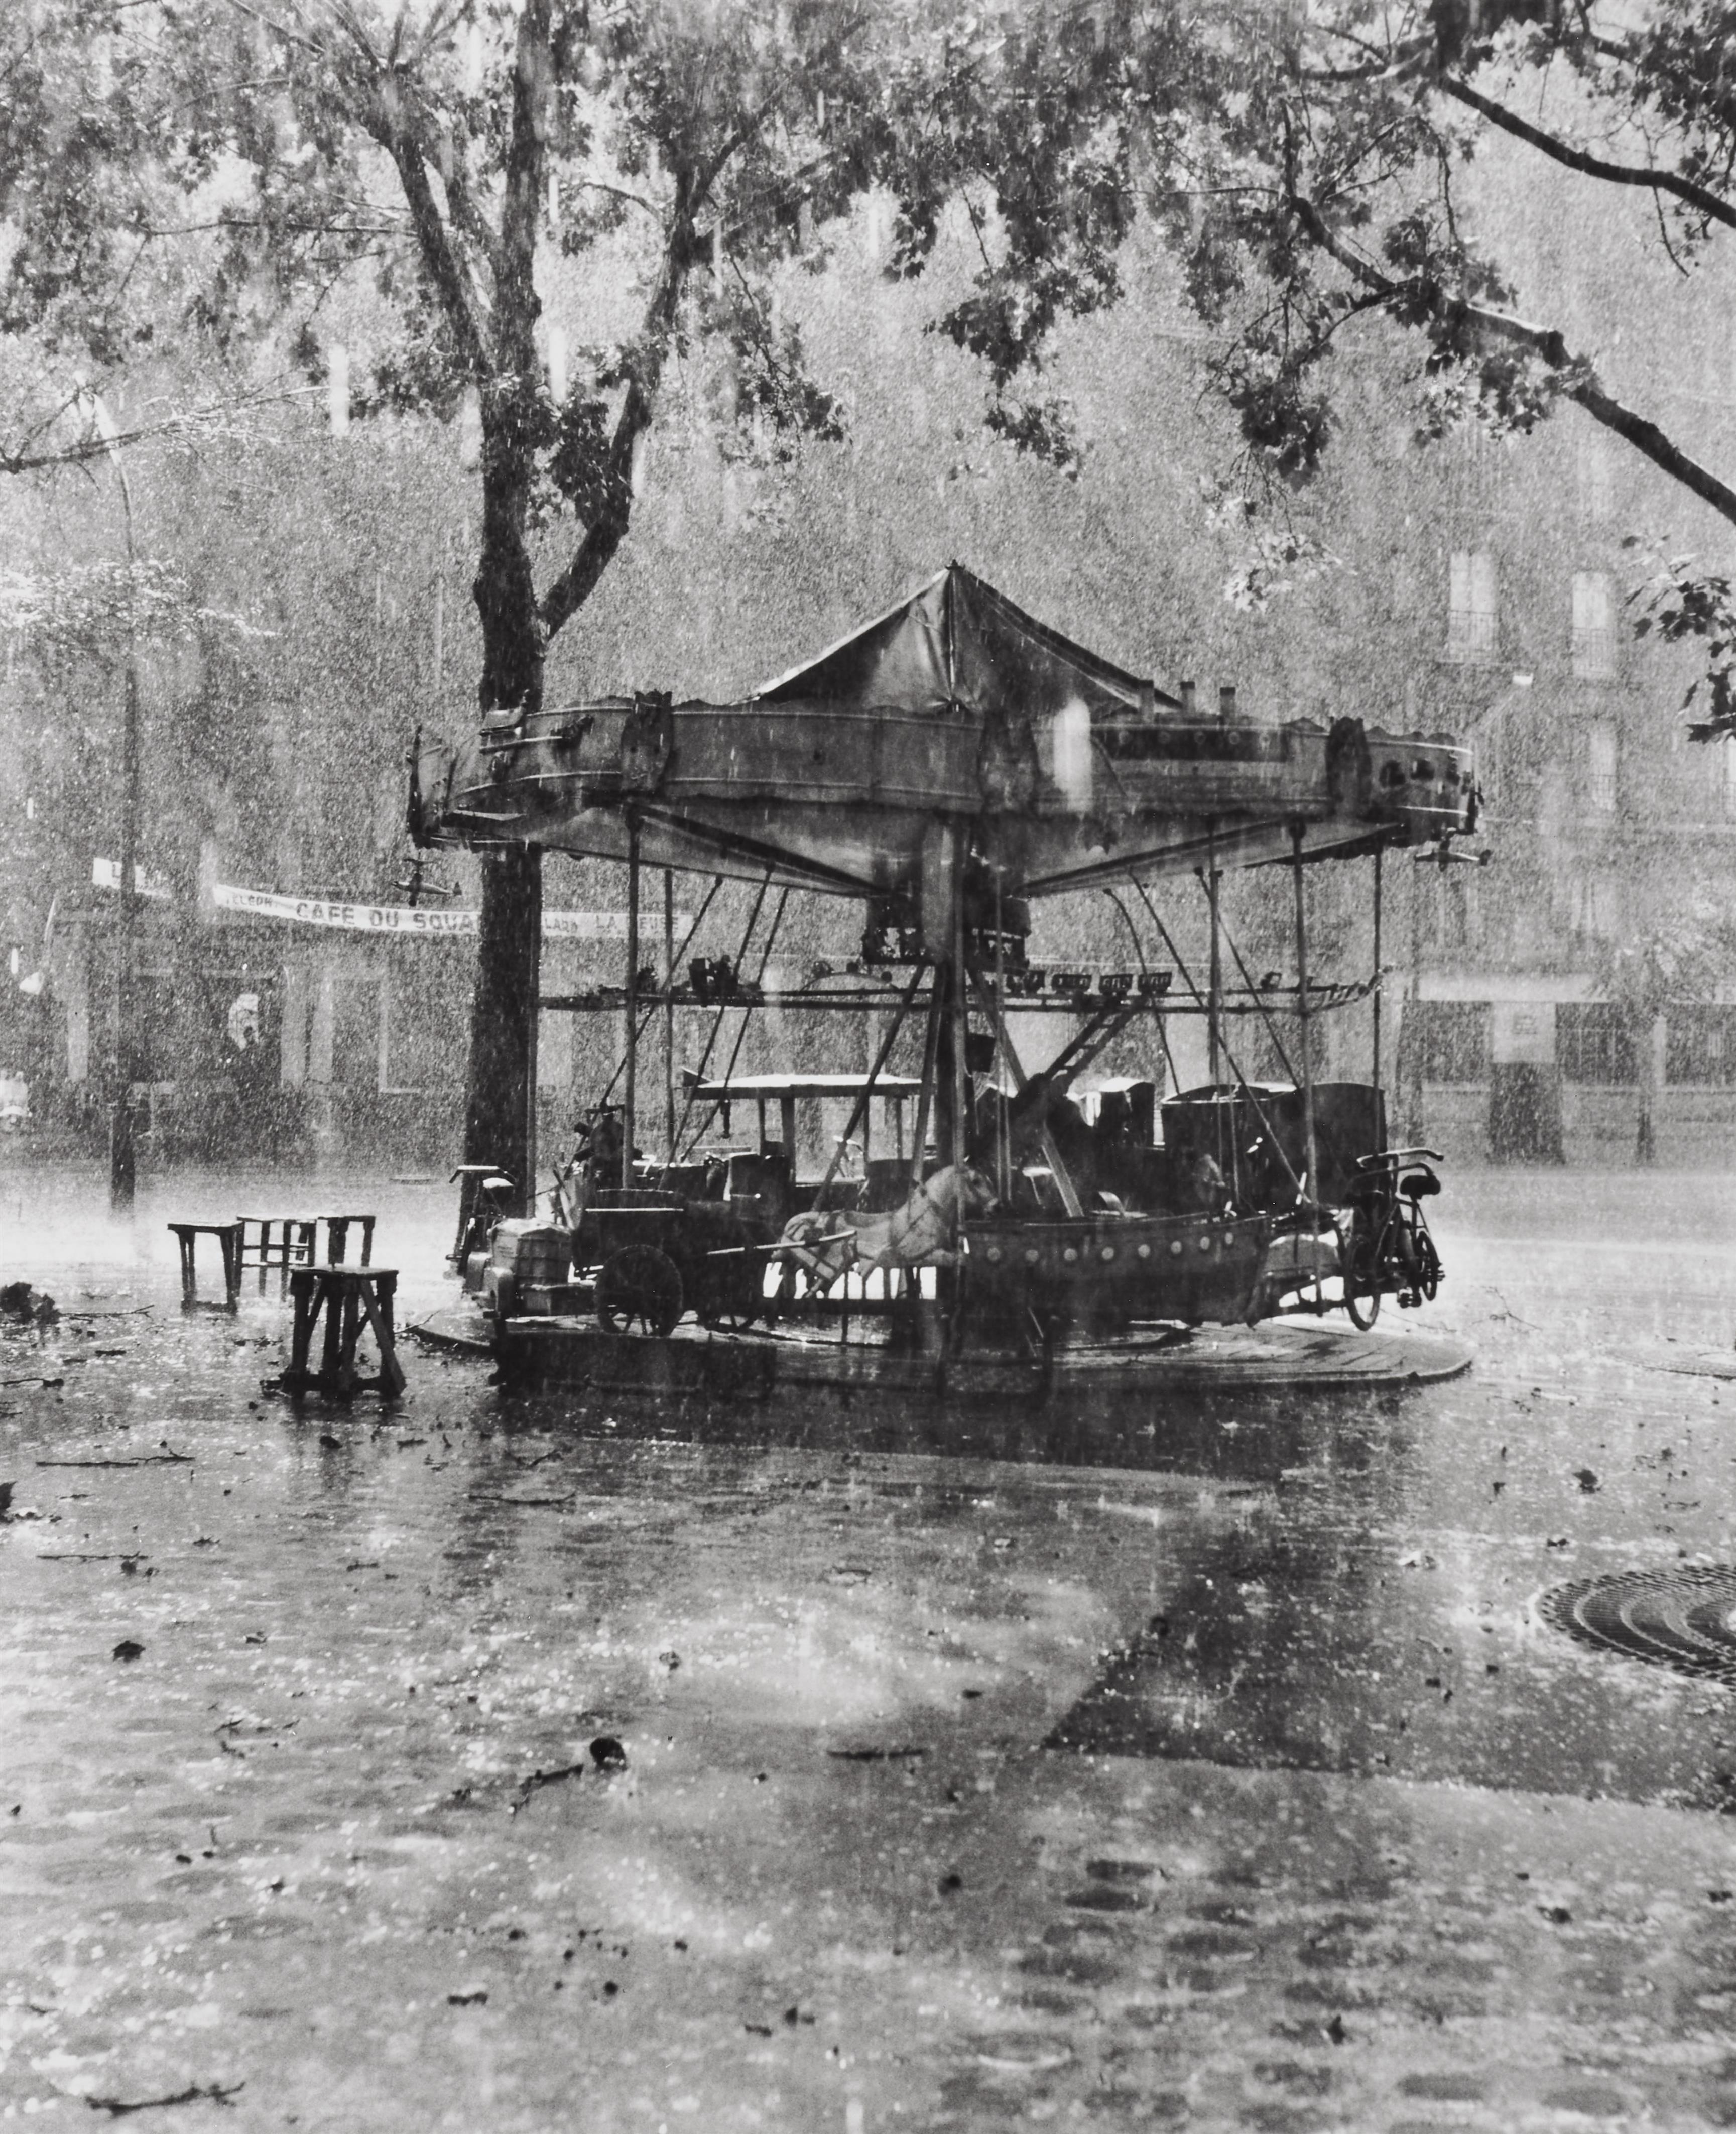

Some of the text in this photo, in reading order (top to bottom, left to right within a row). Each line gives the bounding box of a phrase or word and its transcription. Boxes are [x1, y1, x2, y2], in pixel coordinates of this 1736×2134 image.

[369, 909, 399, 928] DU
[413, 907, 481, 930] SQUA
[626, 916, 678, 930] EUSE
